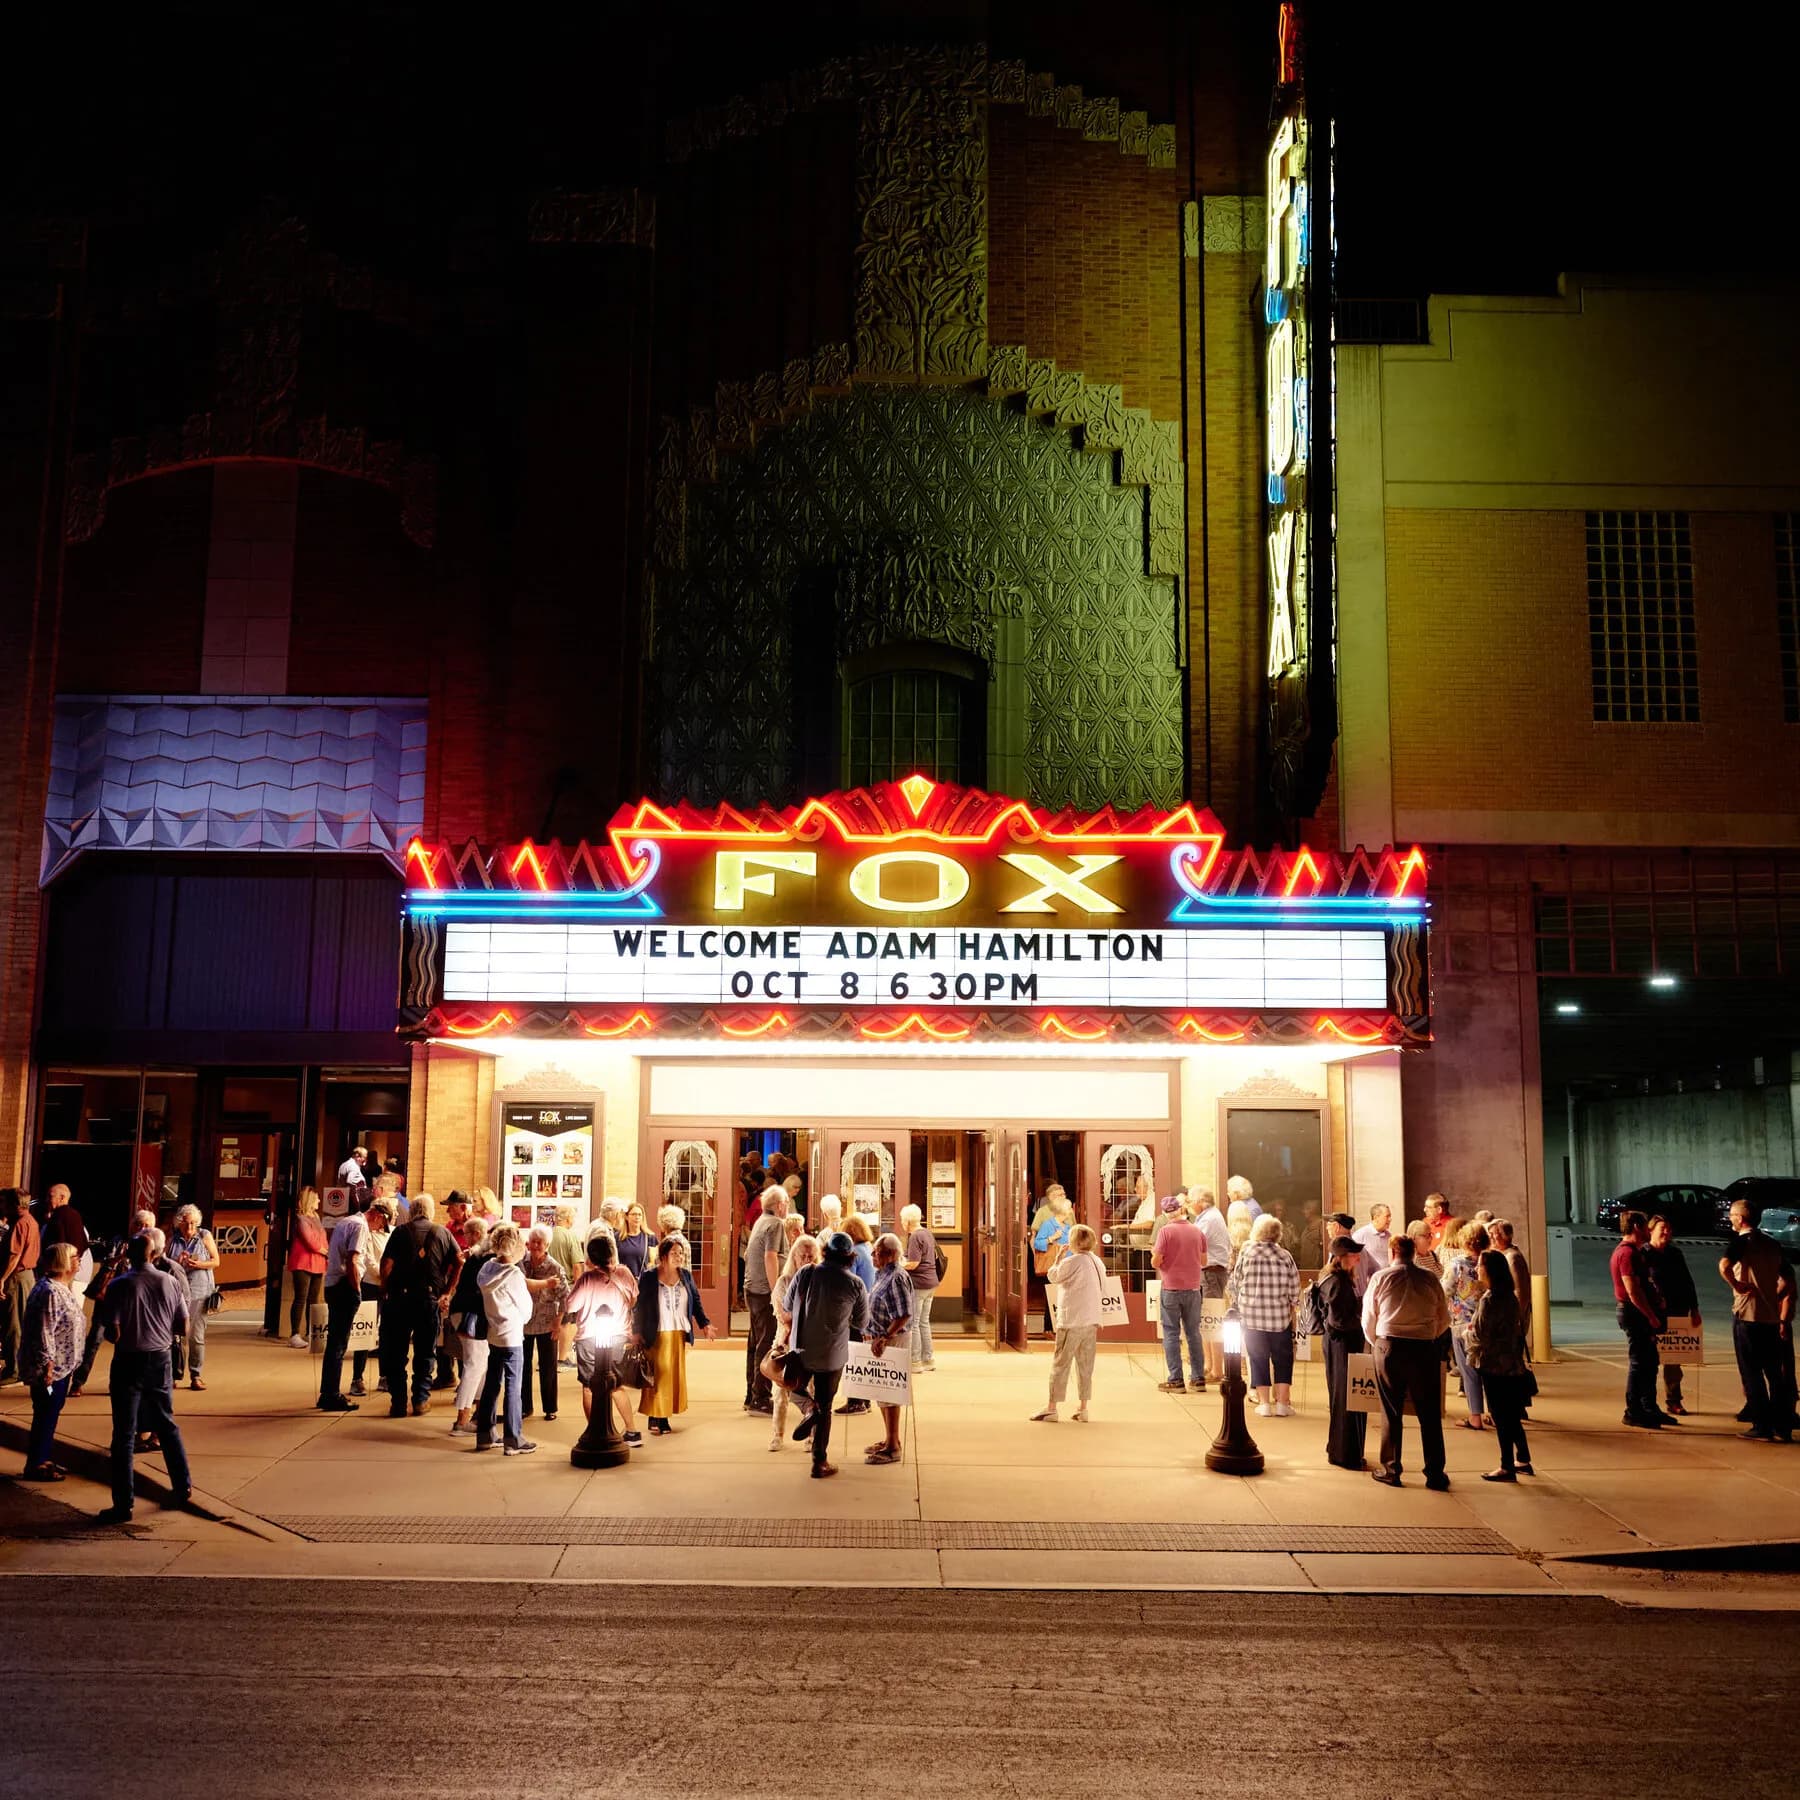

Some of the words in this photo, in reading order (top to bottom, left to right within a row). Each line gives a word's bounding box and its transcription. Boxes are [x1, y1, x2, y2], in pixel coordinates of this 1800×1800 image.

[1266, 115, 1299, 680] FOX
[713, 850, 1126, 914] FOX
[613, 929, 801, 959] WELCOME
[826, 931, 936, 960] ADAM
[959, 933, 1163, 962] HAMILTON
[731, 970, 808, 999] OCT
[840, 971, 859, 1000] 8
[215, 1225, 257, 1247] FOX
[1656, 1336, 1700, 1345] MILTON
[845, 1364, 907, 1382] HAMILTON
[869, 1379, 907, 1389] KANSAS
